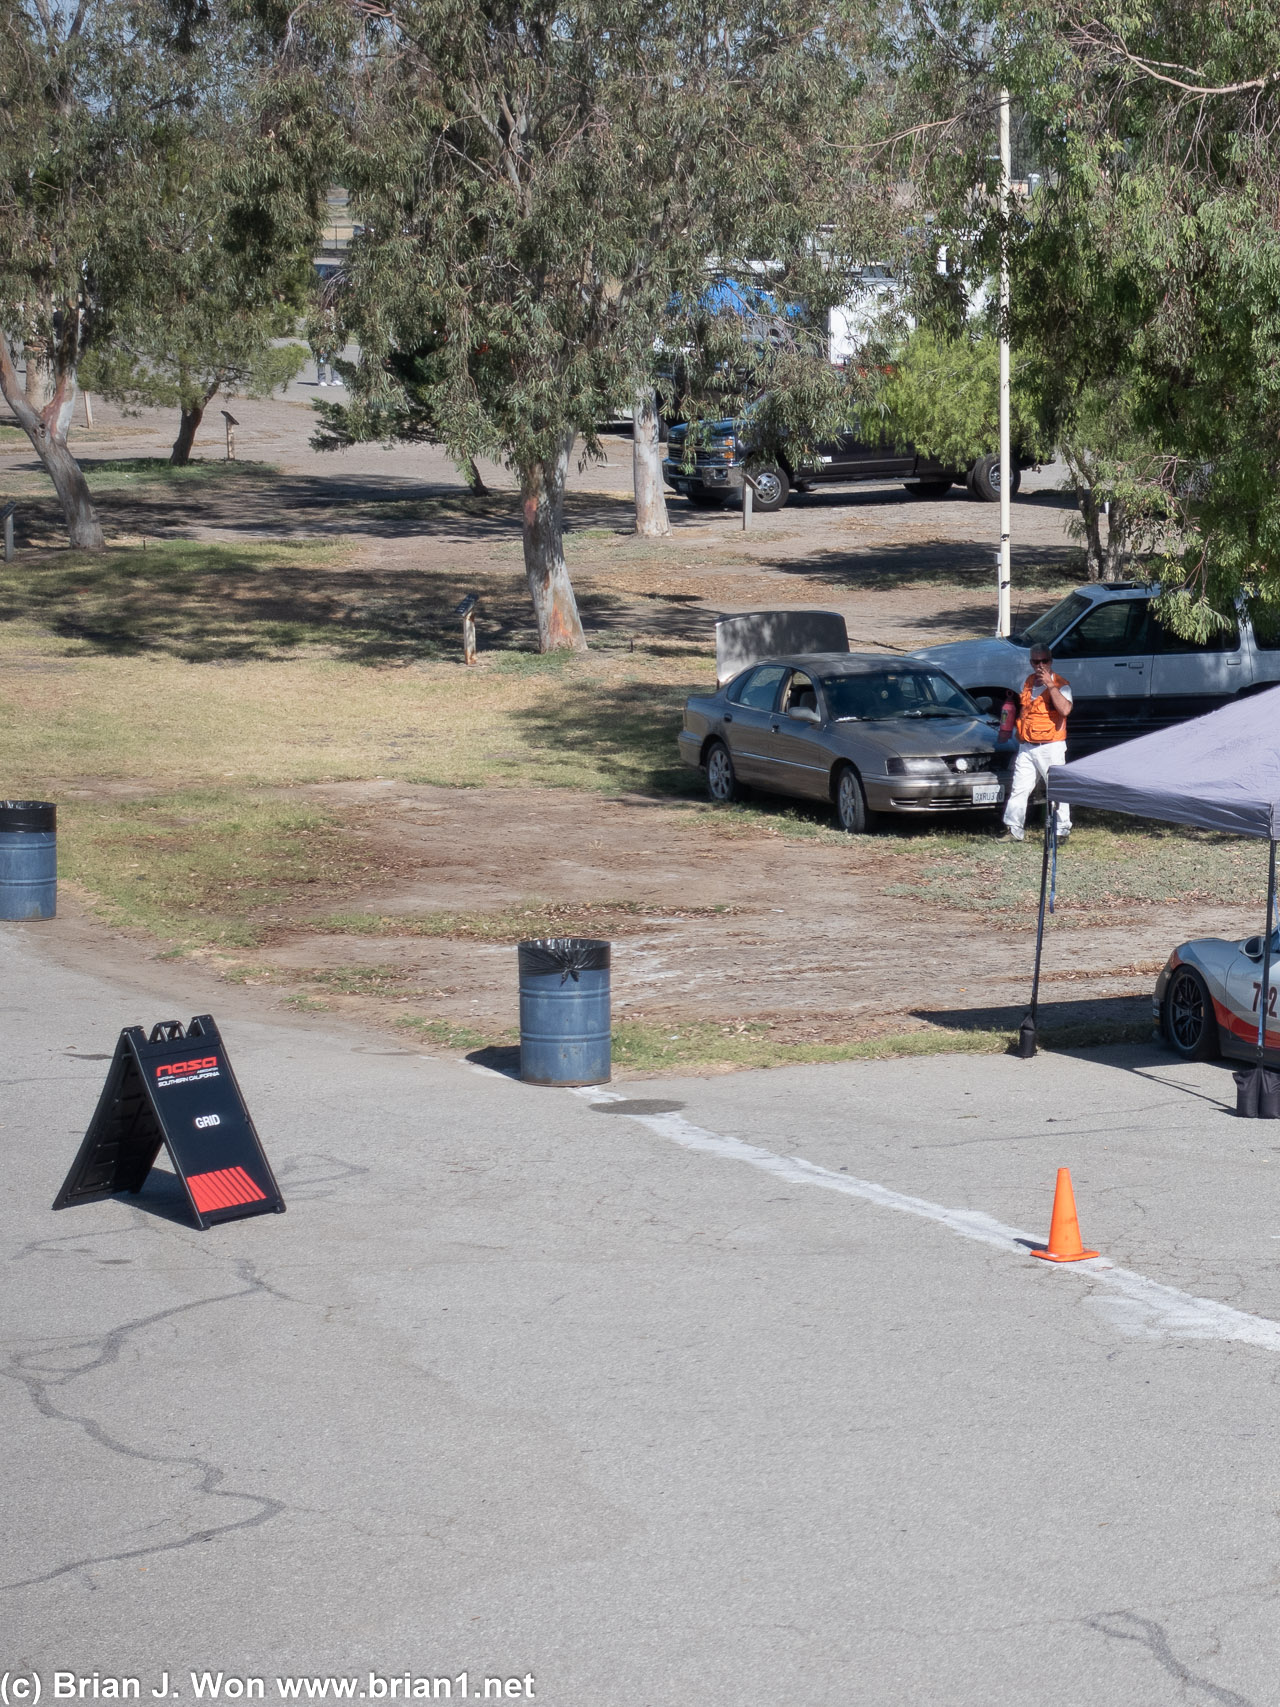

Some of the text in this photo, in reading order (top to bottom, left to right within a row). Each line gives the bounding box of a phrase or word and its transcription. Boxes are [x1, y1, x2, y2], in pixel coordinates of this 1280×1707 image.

[1252, 982, 1278, 1018] 72
[158, 1077, 189, 1087] SOUTHERN
[189, 1072, 220, 1081] CALIFORNIA
[195, 1114, 220, 1128] GRID
